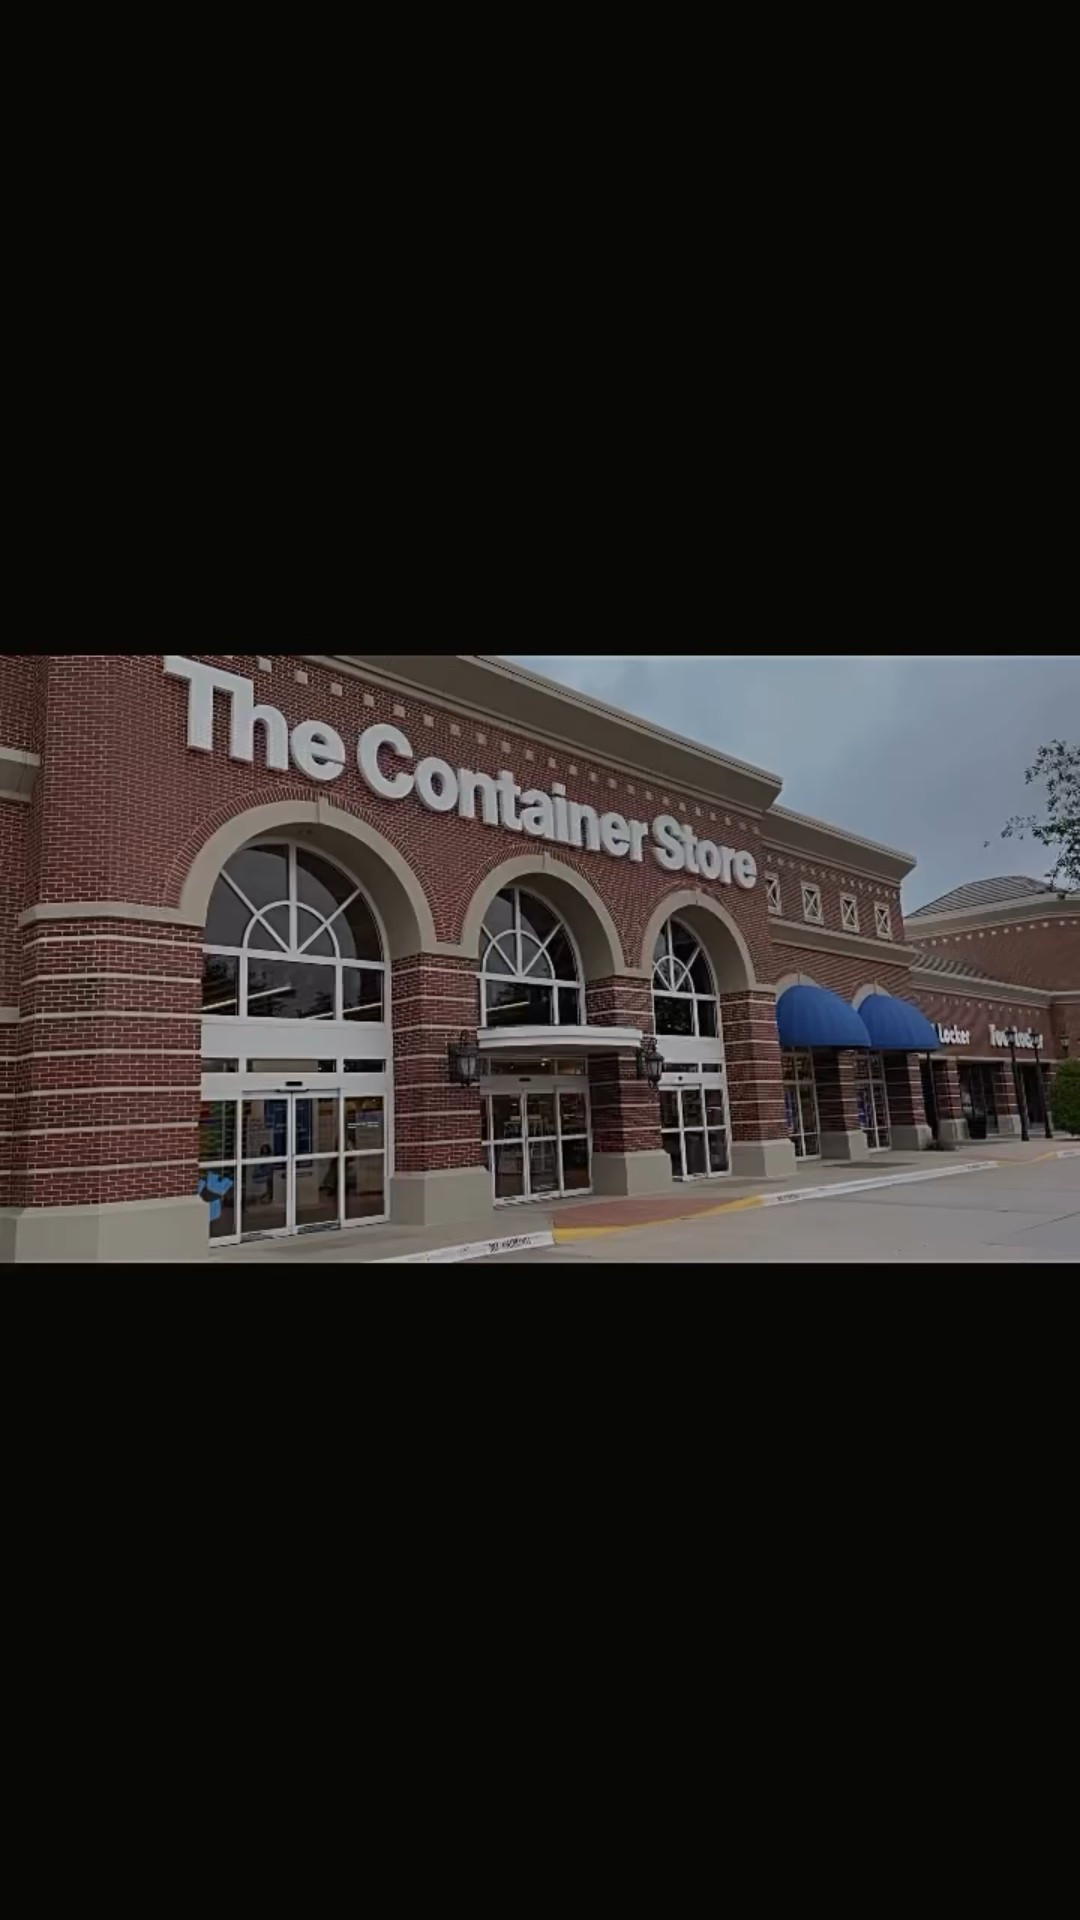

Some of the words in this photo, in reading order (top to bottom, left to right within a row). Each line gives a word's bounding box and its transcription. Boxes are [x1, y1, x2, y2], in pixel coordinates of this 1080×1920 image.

[164, 655, 345, 781] The
[357, 723, 648, 861] Container
[652, 814, 757, 889] Store
[937, 1023, 970, 1045] Locker
